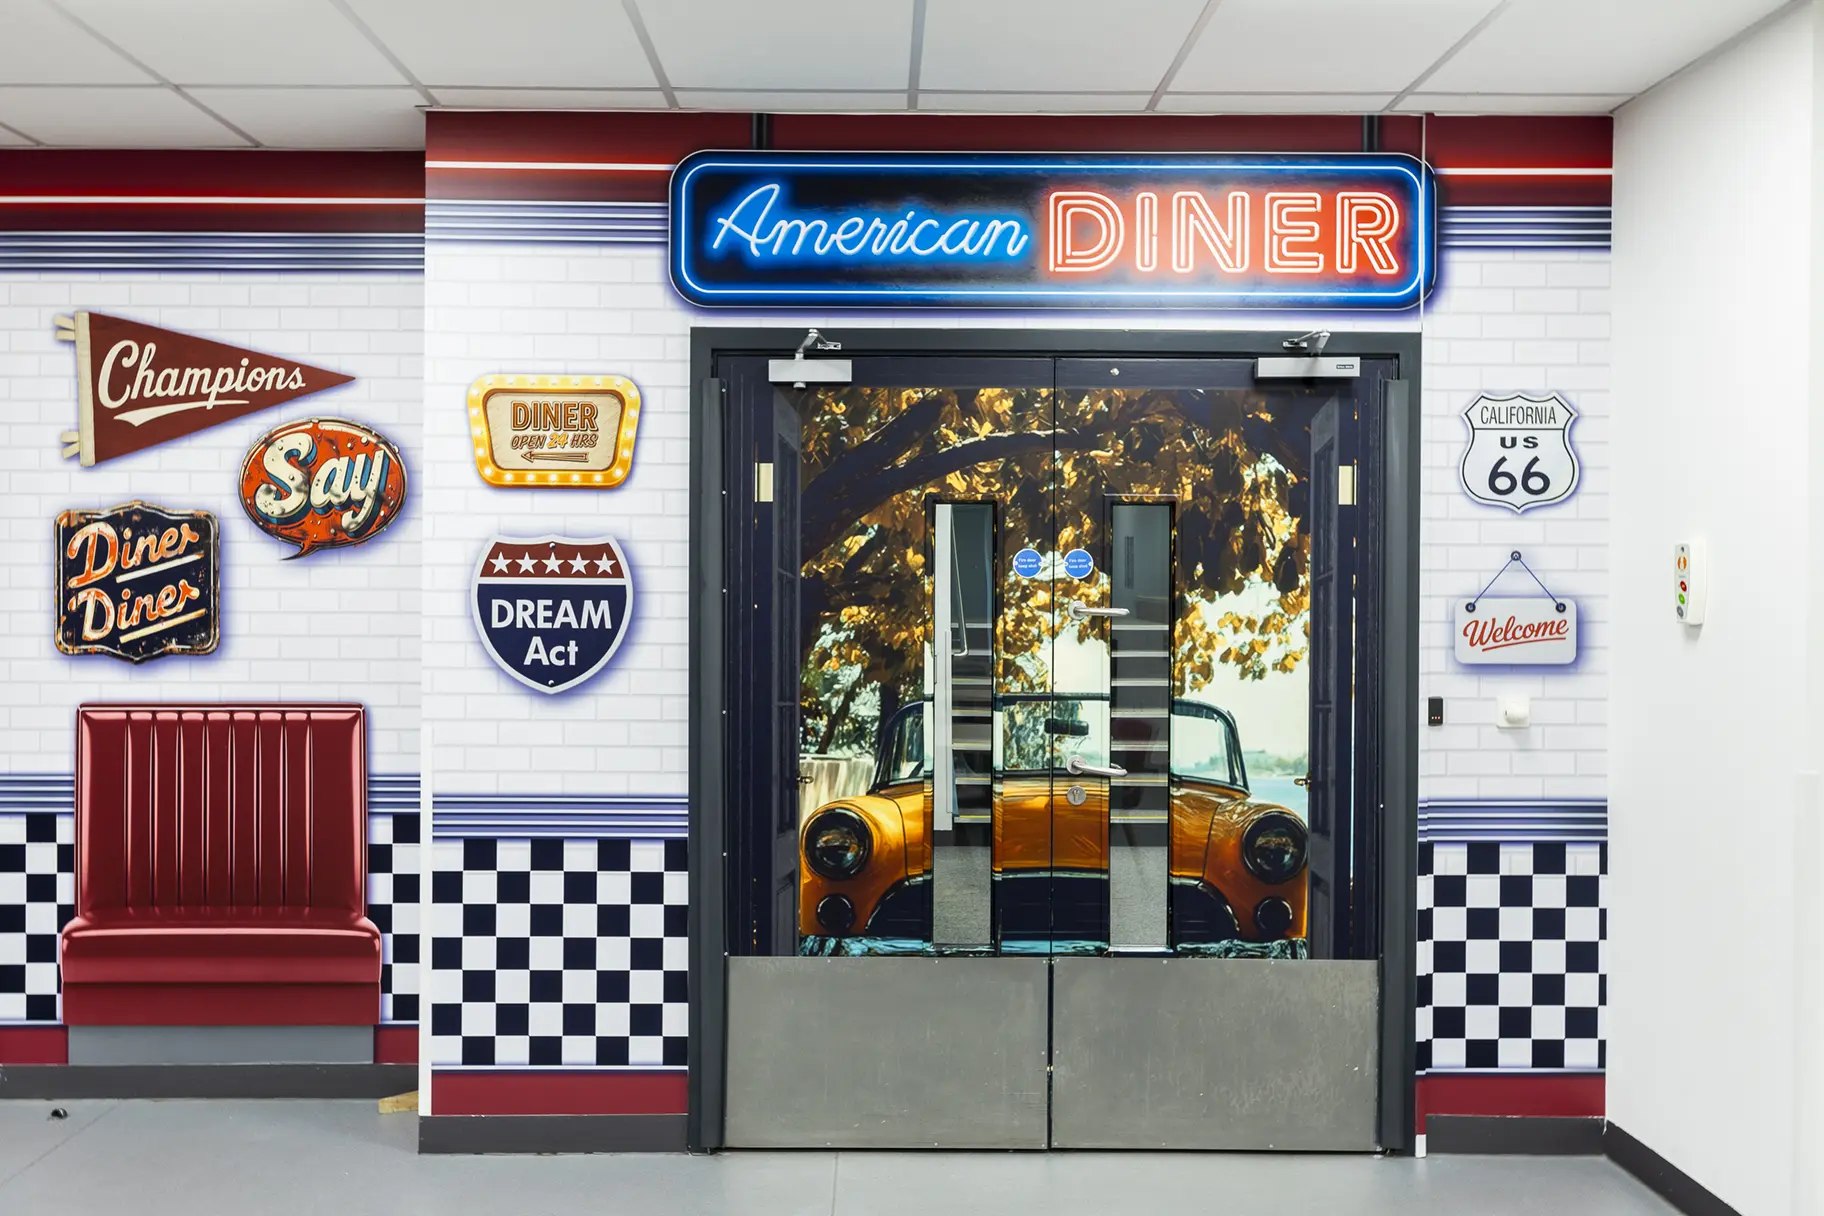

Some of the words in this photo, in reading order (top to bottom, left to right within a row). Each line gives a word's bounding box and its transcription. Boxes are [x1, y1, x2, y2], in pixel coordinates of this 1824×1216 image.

[713, 183, 1029, 257] American
[1047, 190, 1400, 276] DINER
[98, 339, 306, 409] Champions
[511, 400, 598, 432] DINER
[1480, 405, 1557, 425] CALIFORNIA
[511, 434, 546, 450] OPEN
[548, 432, 568, 449] 24
[571, 433, 598, 449] HRS
[254, 432, 389, 537] Say
[1488, 455, 1551, 496] 66
[67, 522, 200, 589] Diner
[67, 579, 200, 641] Diner
[491, 599, 612, 629] DREAM
[1462, 616, 1569, 647] Welcome
[523, 636, 578, 665] Act
